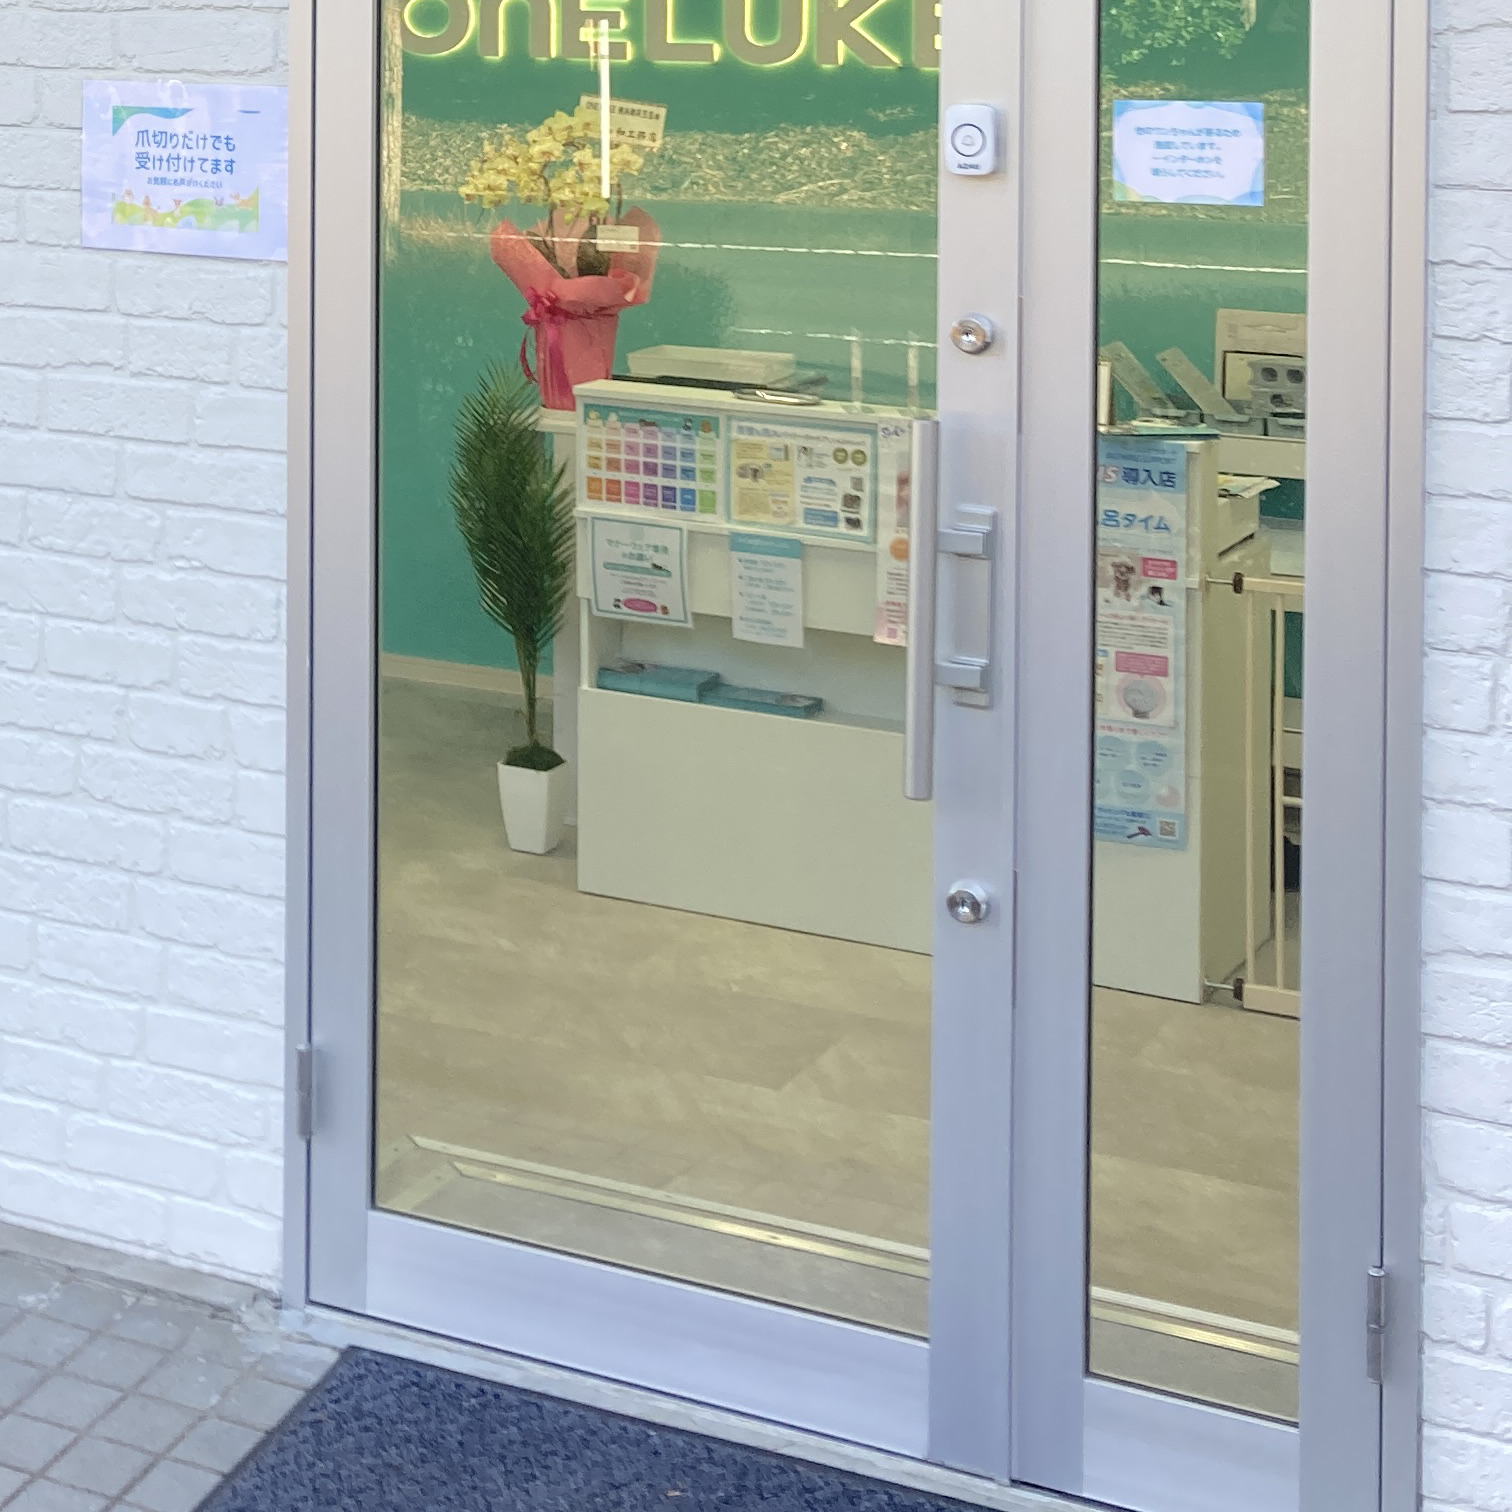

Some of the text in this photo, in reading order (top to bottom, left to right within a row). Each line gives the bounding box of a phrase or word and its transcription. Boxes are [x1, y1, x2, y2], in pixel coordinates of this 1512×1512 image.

[134, 129, 236, 152] 爪切りだけでも
[134, 151, 236, 175] 受け付けてます
[1122, 467, 1177, 488] 導入店
[1100, 509, 1171, 533] 呂タイム
